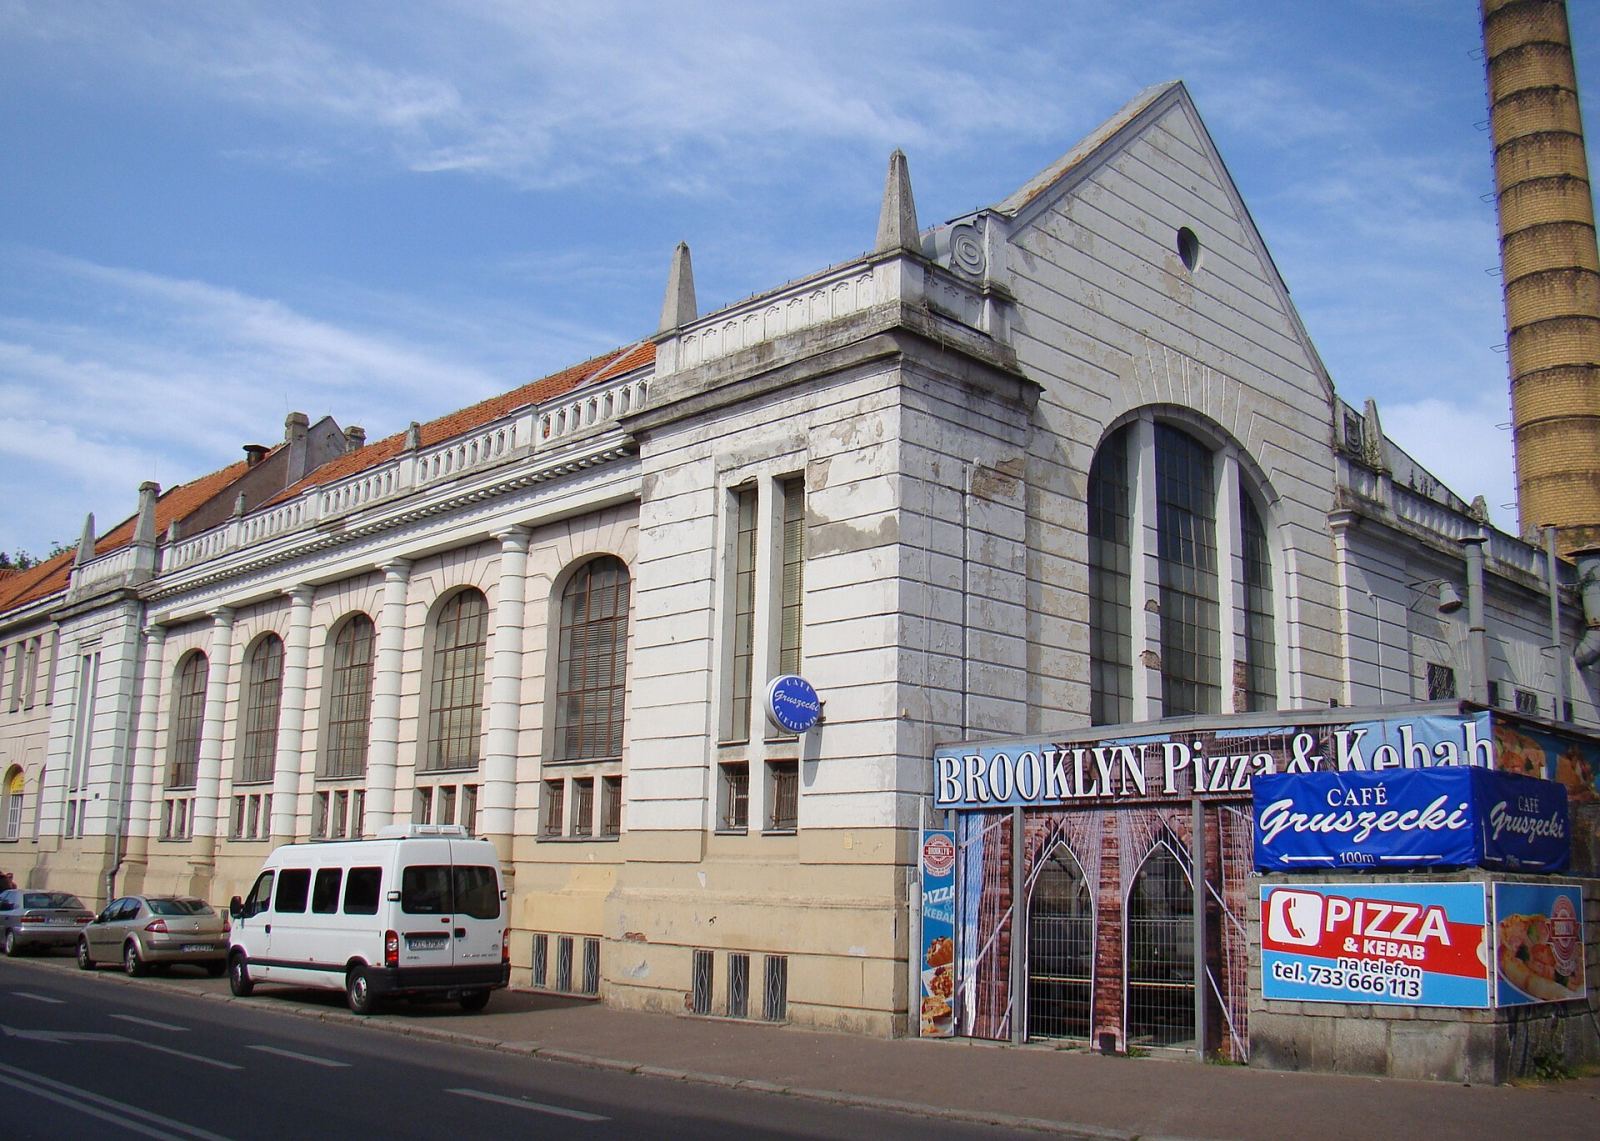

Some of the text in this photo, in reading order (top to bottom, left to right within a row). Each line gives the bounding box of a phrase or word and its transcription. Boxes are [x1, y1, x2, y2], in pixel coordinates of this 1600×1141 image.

[774, 689, 819, 712] Gruszecki
[937, 746, 1147, 803] BROOKLYN
[1161, 741, 1277, 795] Pizza
[1286, 732, 1324, 774] &
[1327, 782, 1388, 806] CAFÉ
[1259, 794, 1469, 845] Gruszecki
[1490, 801, 1564, 844] Gruszecki
[1339, 851, 1375, 863] 100m
[1325, 898, 1451, 946] PIZZA
[1343, 937, 1425, 960] & KEBAB
[1274, 962, 1419, 997] tel. 733 666 113
[1339, 958, 1421, 980] na telefon
